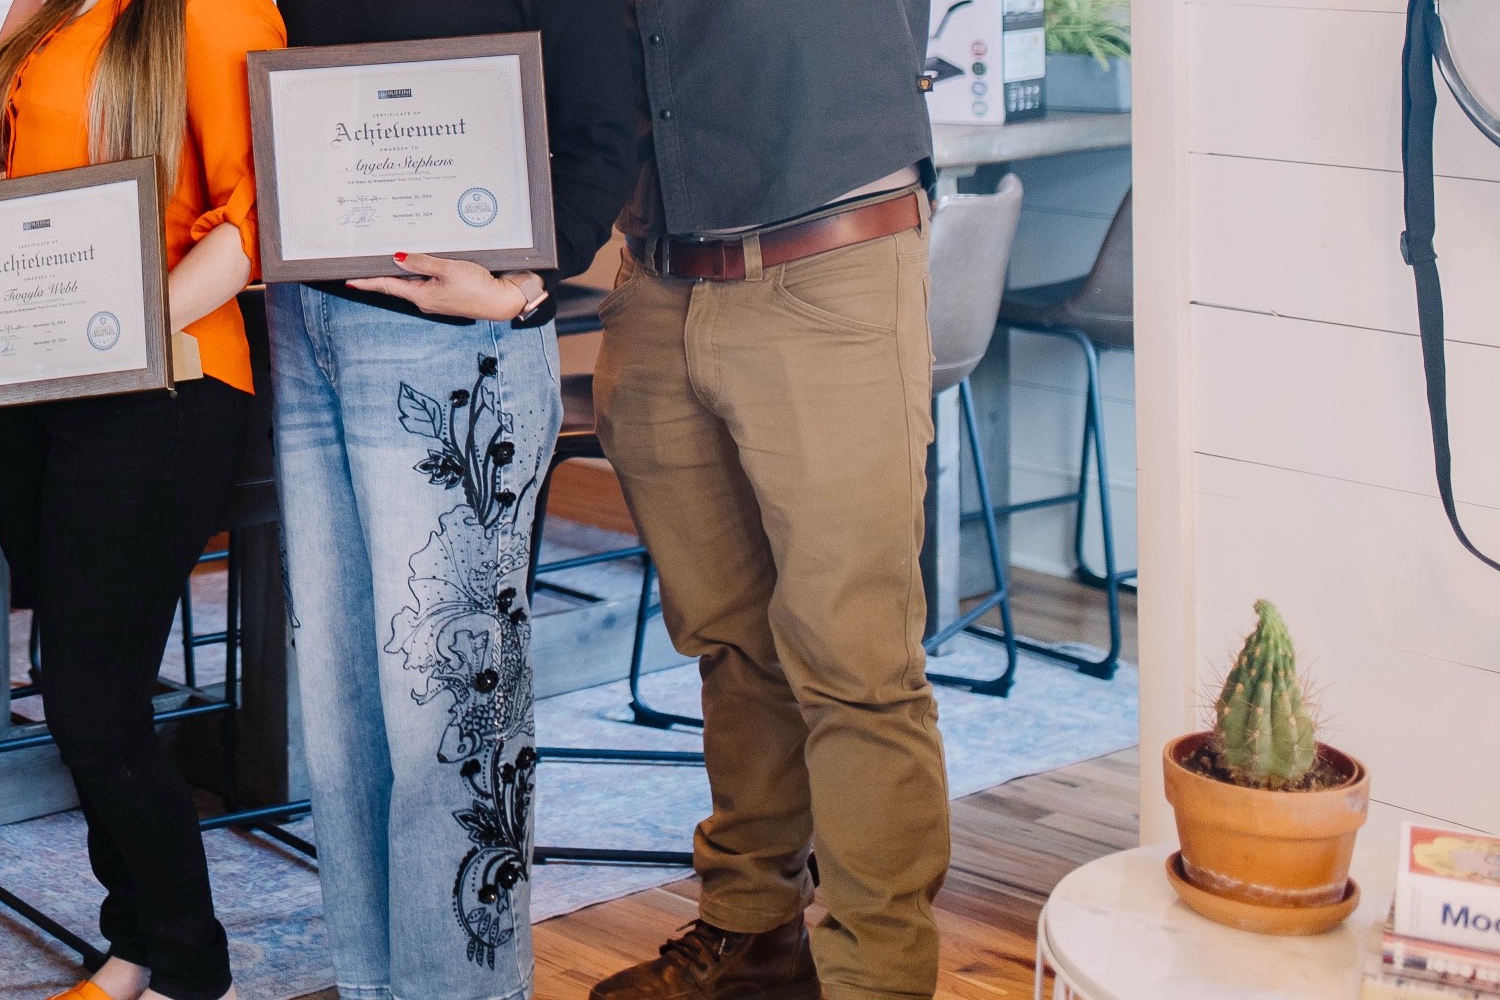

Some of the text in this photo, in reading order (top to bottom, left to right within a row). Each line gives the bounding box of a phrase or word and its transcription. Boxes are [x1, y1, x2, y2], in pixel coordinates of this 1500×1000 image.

[330, 118, 466, 148] Achievement
[345, 155, 454, 175] Angela Stephens
[3, 285, 44, 303] Twayla
[47, 280, 78, 295] Webb
